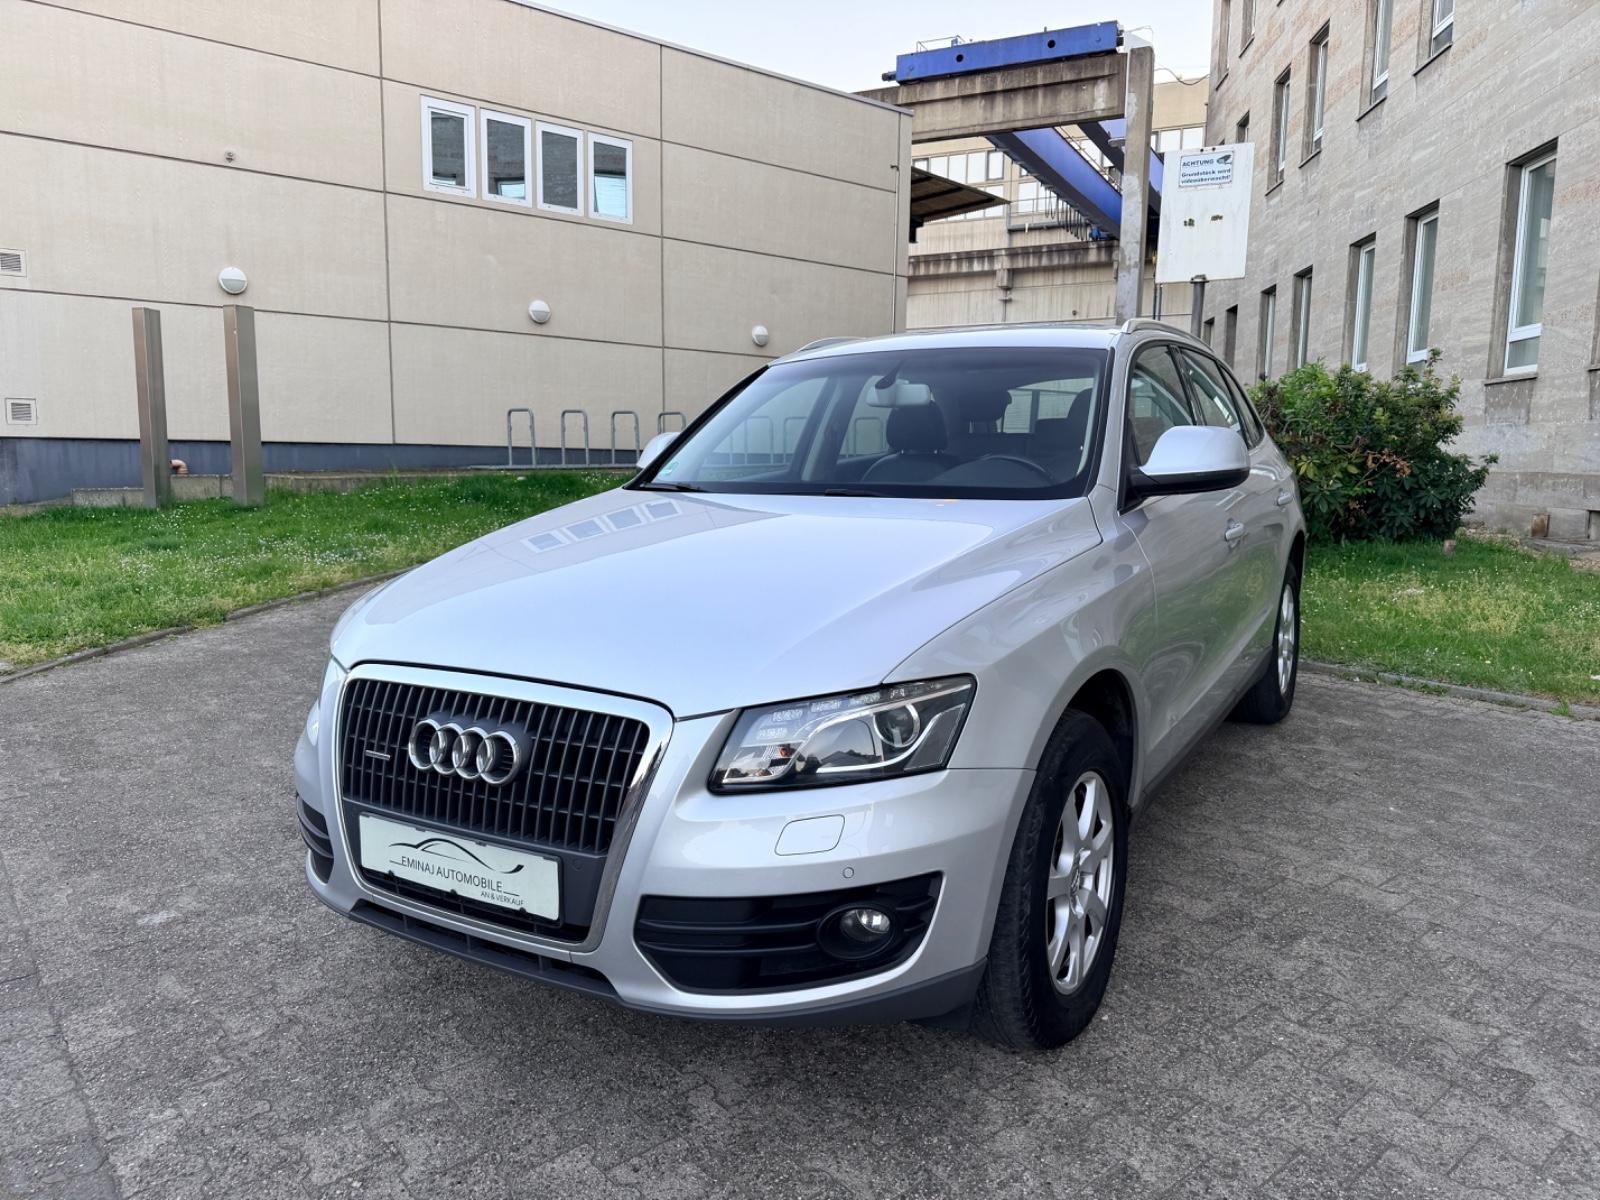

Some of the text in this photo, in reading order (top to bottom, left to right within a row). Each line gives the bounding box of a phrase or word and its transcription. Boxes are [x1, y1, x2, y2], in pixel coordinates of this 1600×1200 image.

[1182, 159, 1214, 167] ACHTUNG
[401, 856, 503, 893] EMINAJ AUTOMOBILE
[480, 891, 491, 899] AN
[496, 894, 525, 906] VERKAUF
